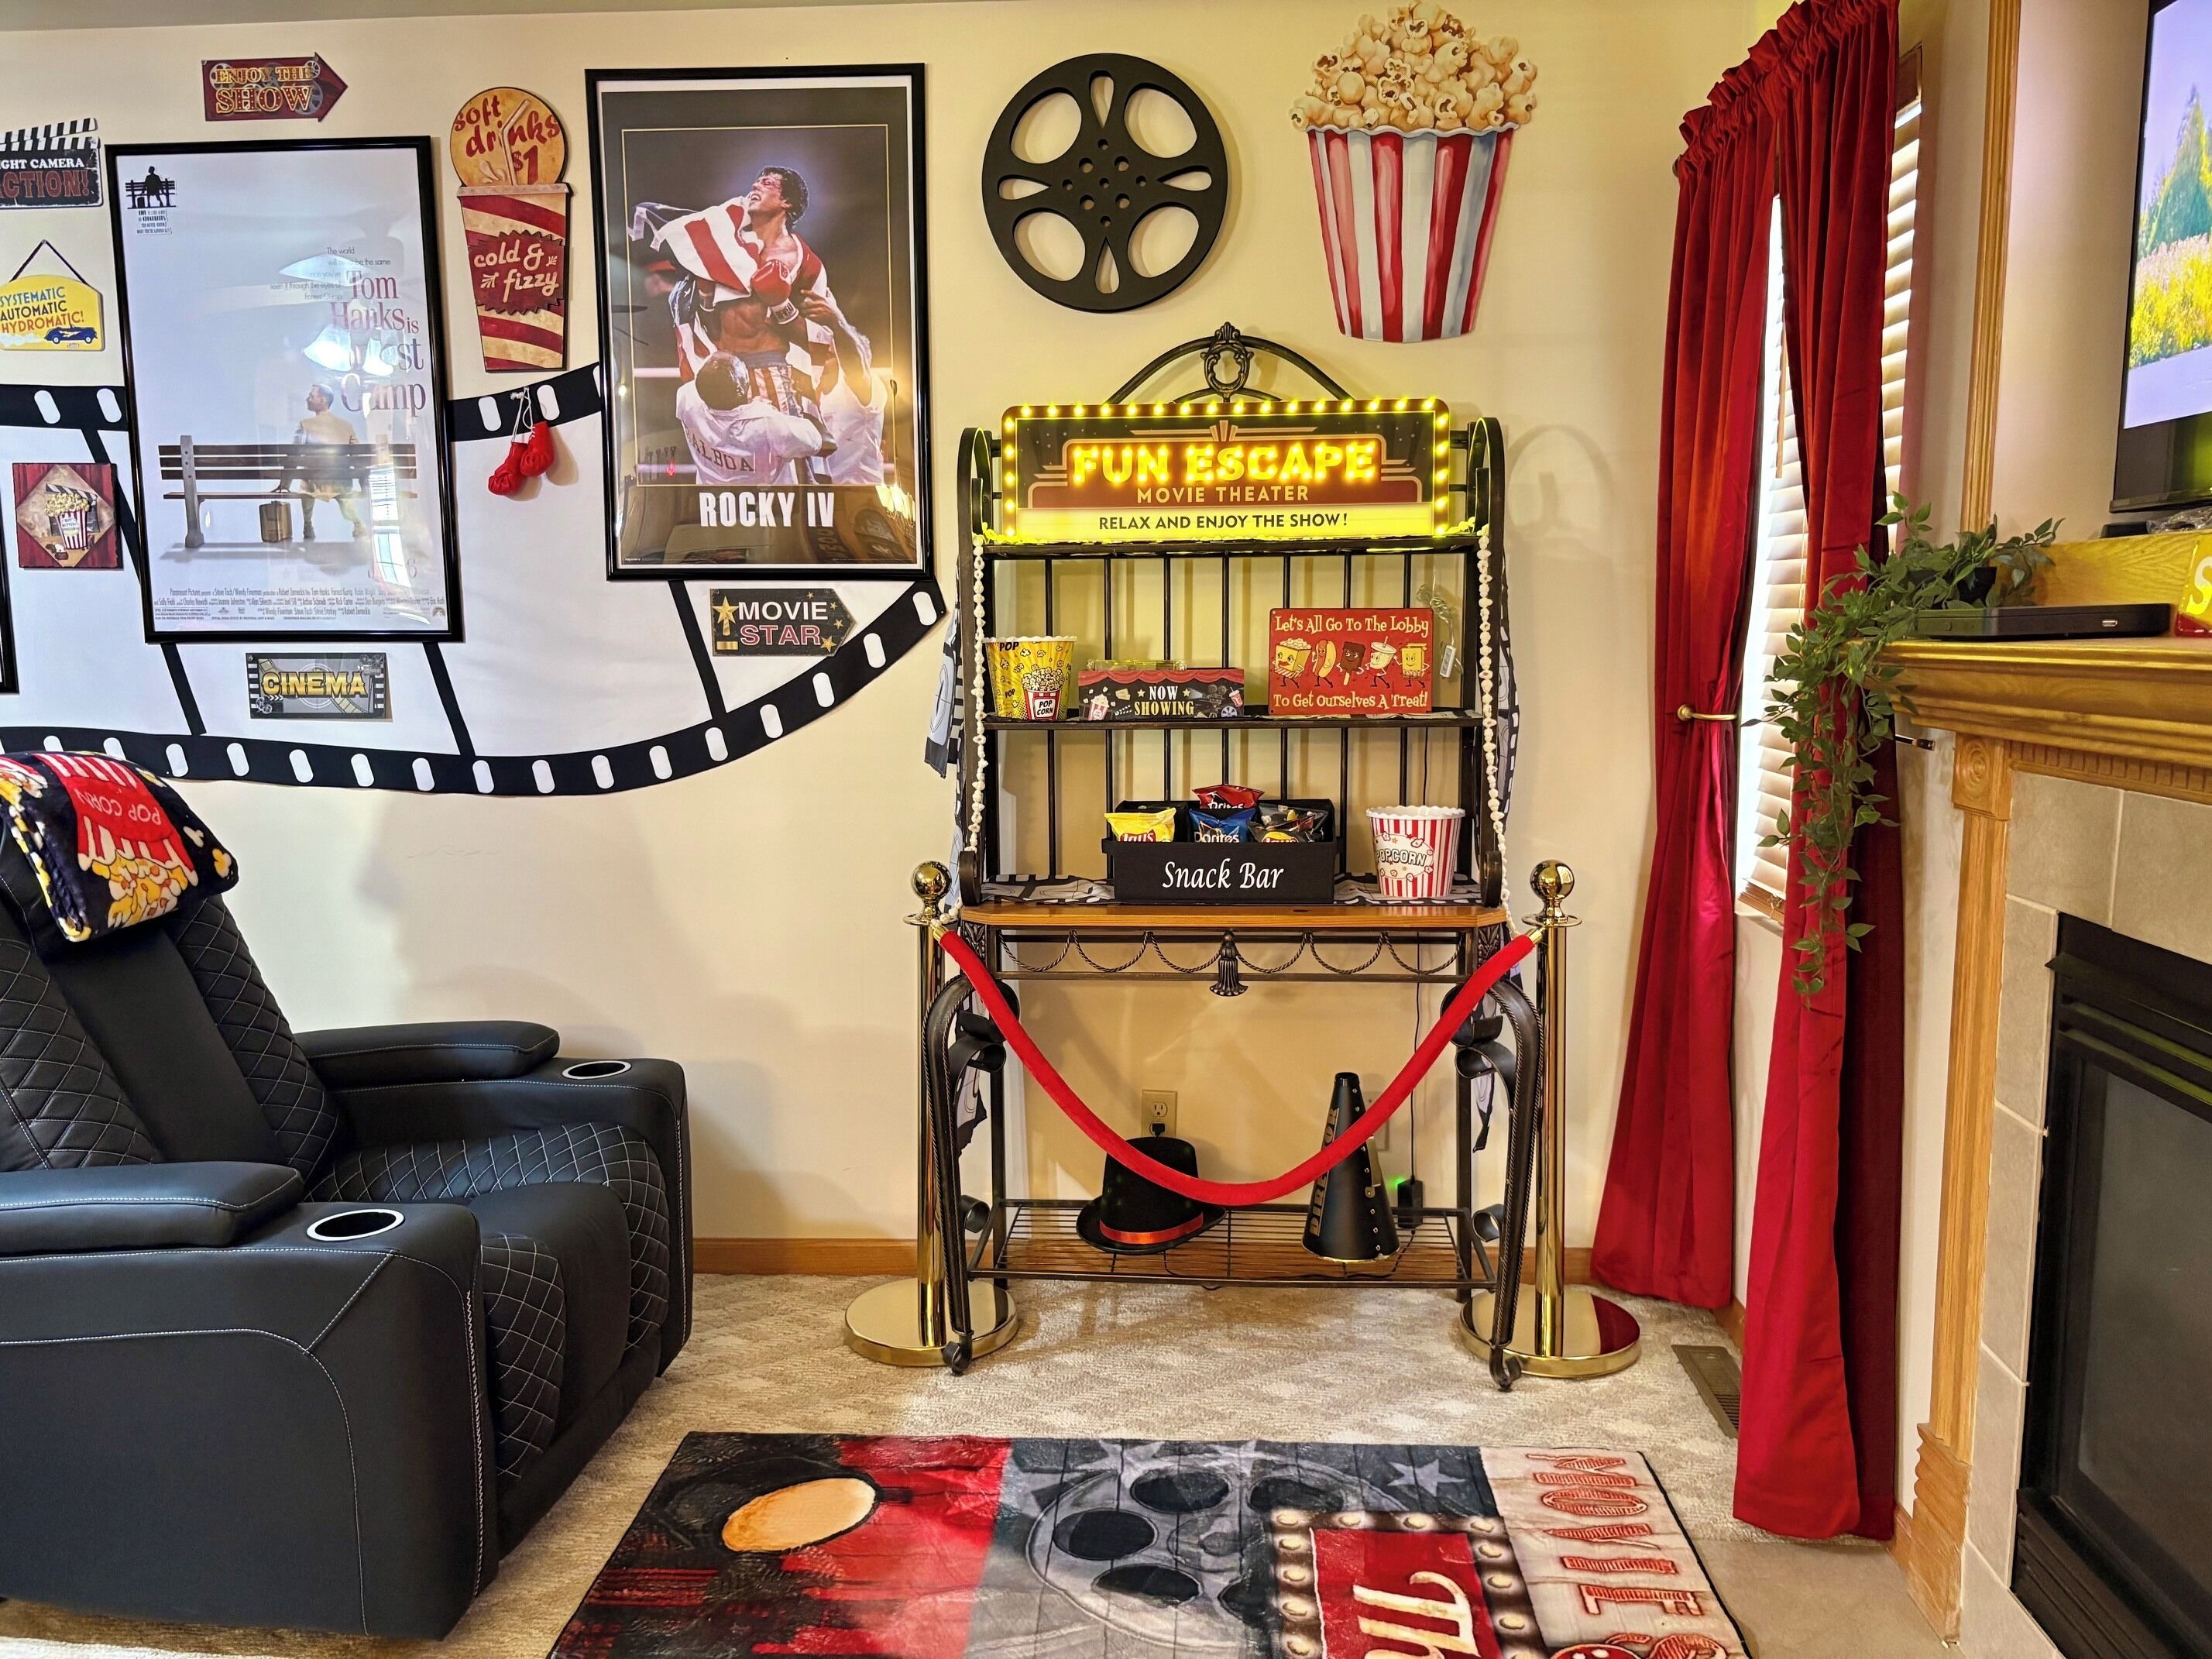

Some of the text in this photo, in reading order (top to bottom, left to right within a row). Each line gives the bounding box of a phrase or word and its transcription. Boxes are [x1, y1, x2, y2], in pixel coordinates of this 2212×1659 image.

[215, 66, 314, 84] ENJOY THE
[215, 86, 314, 114] SHOW
[454, 94, 501, 132] soft
[0, 157, 85, 170] GHT CAMERA
[511, 145, 539, 185] $1
[0, 170, 90, 198] CTION!
[473, 239, 544, 271] cold &
[346, 270, 399, 300] Tom
[503, 268, 559, 303] fizzy
[0, 286, 66, 308] SYSTEMATIC
[0, 300, 68, 322] AUTOMATIC
[330, 301, 419, 334] Hanks is
[2, 311, 84, 334] HYDROMATIC!
[1072, 444, 1376, 483] FUN ESCAPE
[1136, 485, 1310, 504] MOVIE THEATER
[699, 491, 836, 528] ROCKY IV
[1098, 517, 1151, 530] RELAX
[1156, 515, 1191, 529] AND
[1196, 514, 1249, 529] ENJOY
[1252, 514, 1286, 527] THE
[738, 601, 829, 620] MOVIE
[740, 624, 822, 646] STAR
[1274, 614, 1429, 639] Let's All Go To The Lobby
[999, 641, 1019, 652] POP
[261, 671, 368, 698] CINEMA
[1005, 688, 1016, 699] POP
[1149, 685, 1179, 701] NOW
[1036, 707, 1054, 716] CORN
[1039, 700, 1053, 709] POP
[1134, 701, 1195, 716] SHOWING
[1273, 691, 1428, 710] To Get Ourselves A Treat!
[74, 788, 161, 826] POP CORN
[1194, 831, 1240, 843] Doritos
[1376, 848, 1427, 867] POPCORN
[1162, 857, 1284, 889] Snack Bar
[1309, 1108, 1338, 1237] DIREOR
[1525, 1452, 1705, 1616] MOVIE
